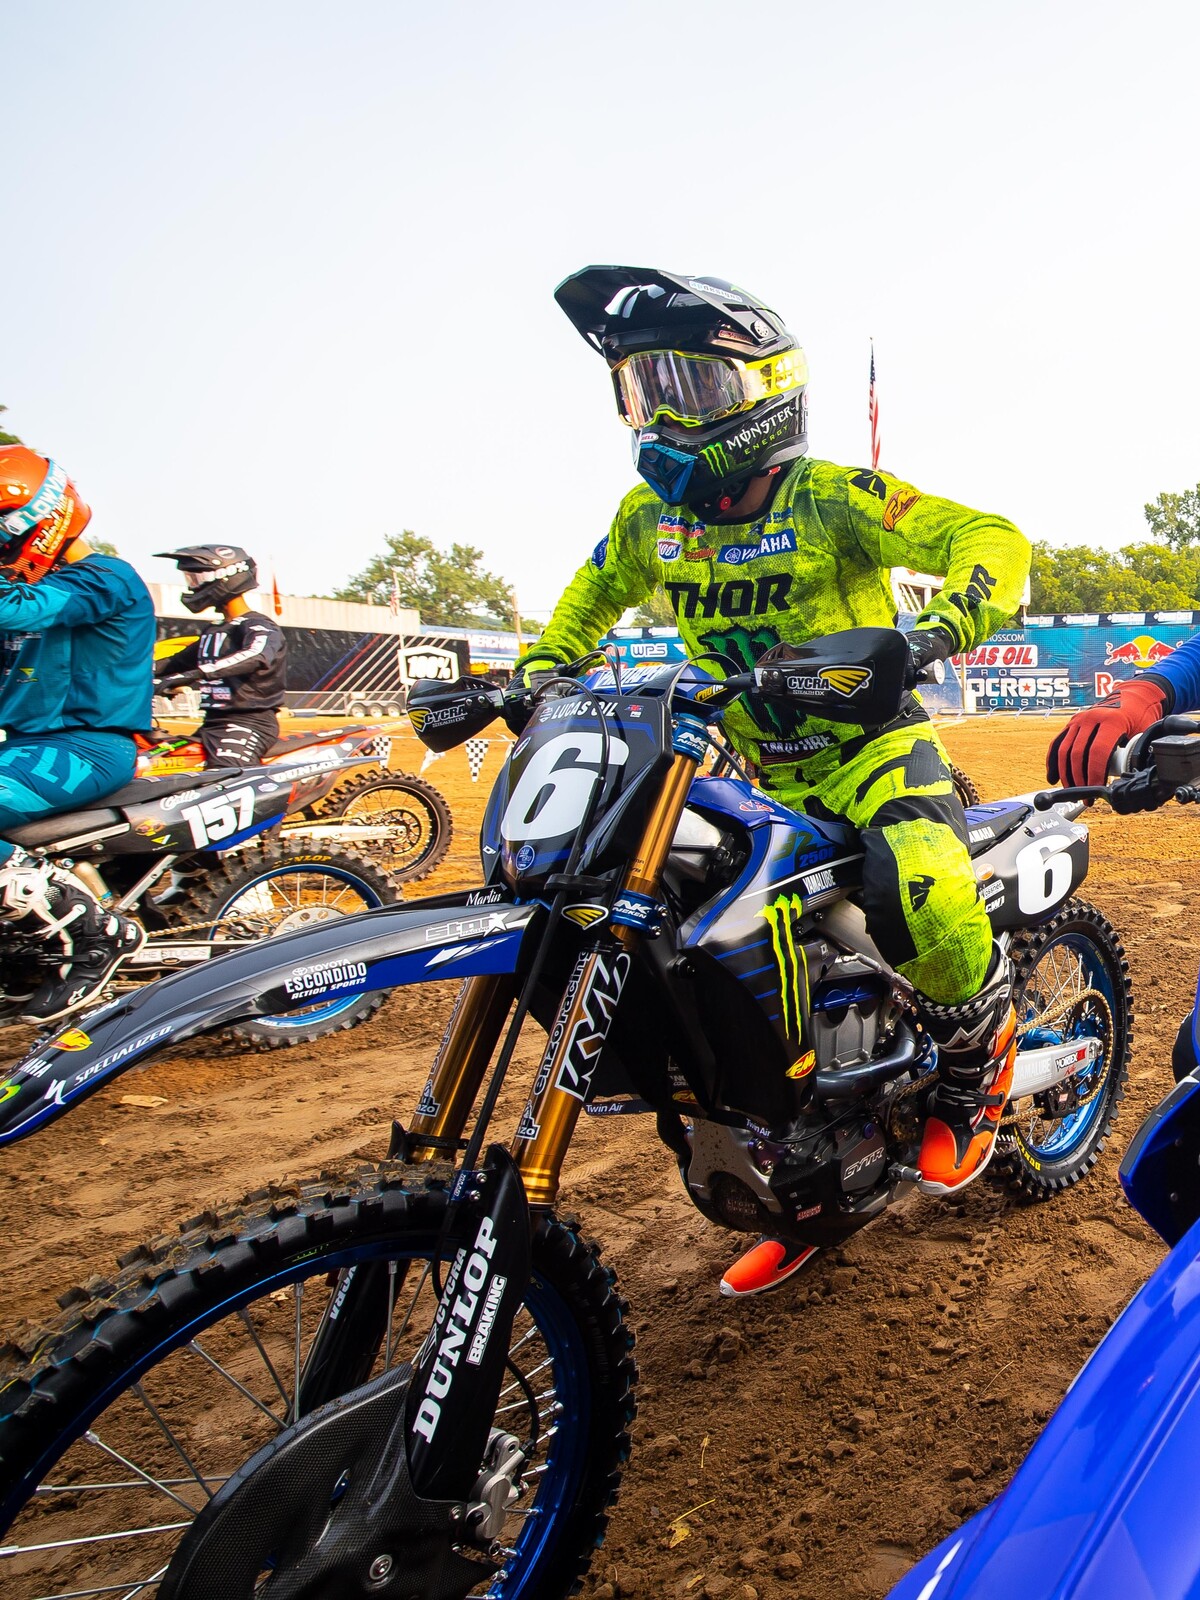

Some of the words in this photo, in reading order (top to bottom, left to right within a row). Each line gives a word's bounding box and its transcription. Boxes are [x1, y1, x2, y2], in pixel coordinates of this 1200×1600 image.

[726, 404, 795, 451] MONSTER
[744, 424, 789, 455] ENERGY
[664, 572, 794, 619] THOR
[985, 633, 1025, 642] ROSS.COM
[631, 644, 667, 657] WPS
[952, 647, 997, 667] UCAS
[1002, 646, 1035, 666] OIL
[407, 655, 452, 680] 100%
[966, 668, 1008, 676] PRO
[787, 676, 831, 690] CYCRA
[966, 677, 1071, 698] OCROSS
[424, 703, 468, 725] CYCRA
[551, 700, 592, 720] LUCAS
[980, 698, 1071, 707] IONSHIP
[216, 723, 252, 759] FLY
[0, 744, 94, 795] FLY
[272, 757, 345, 784] DUNLOP
[501, 732, 629, 841] 6
[181, 785, 256, 850] 157
[802, 869, 837, 896] YAMALUBE
[1016, 834, 1073, 915] 6
[466, 888, 503, 907] Martin
[613, 899, 653, 915] NK
[612, 907, 648, 920] NEKEN
[307, 958, 351, 972] TOYOTA
[284, 961, 368, 994] ESCONDIDO
[291, 986, 326, 1000] ACTION
[330, 977, 367, 991] SPORTS
[585, 1104, 608, 1113] Twin
[608, 1103, 625, 1113] Air
[758, 1125, 772, 1138] Air
[843, 1147, 885, 1182] GYTR
[436, 1247, 468, 1328] CYCRA
[412, 1216, 499, 1444] DUNLOP
[468, 1275, 506, 1364] BRAKING
